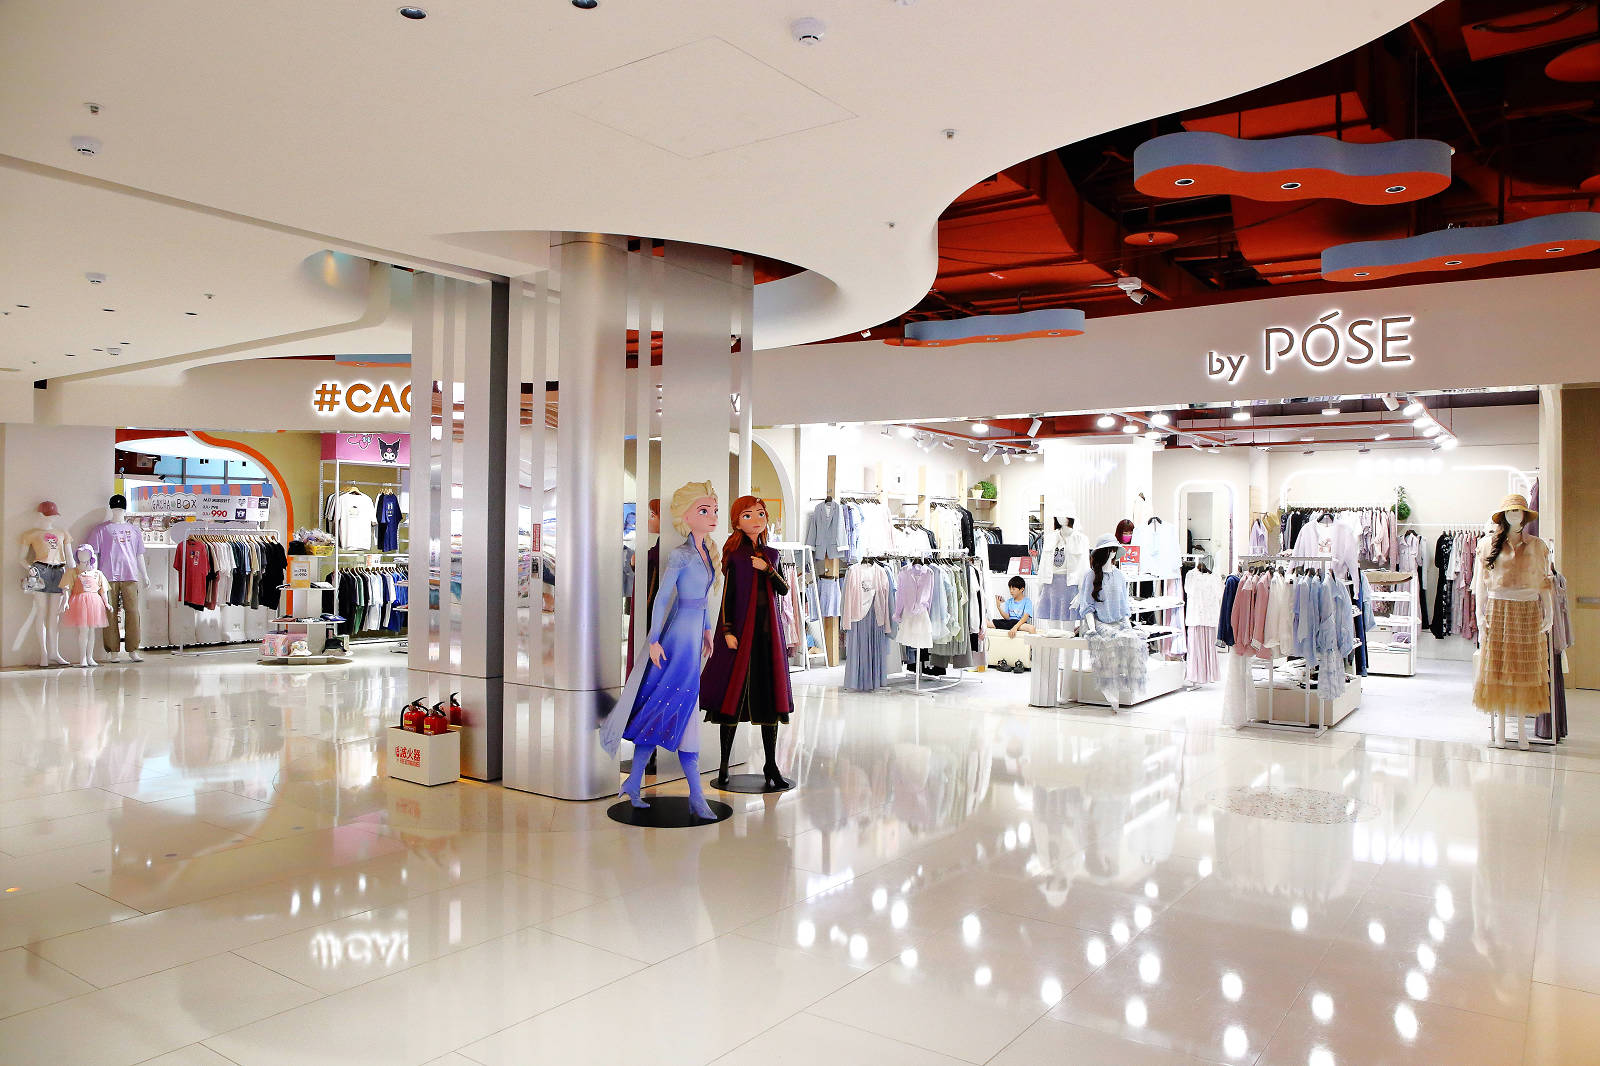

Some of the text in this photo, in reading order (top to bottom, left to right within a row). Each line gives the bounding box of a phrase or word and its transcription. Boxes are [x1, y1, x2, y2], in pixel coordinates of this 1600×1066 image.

[1208, 310, 1413, 382] by PÓSE
[176, 498, 197, 510] BOX
[211, 509, 228, 518] 990
